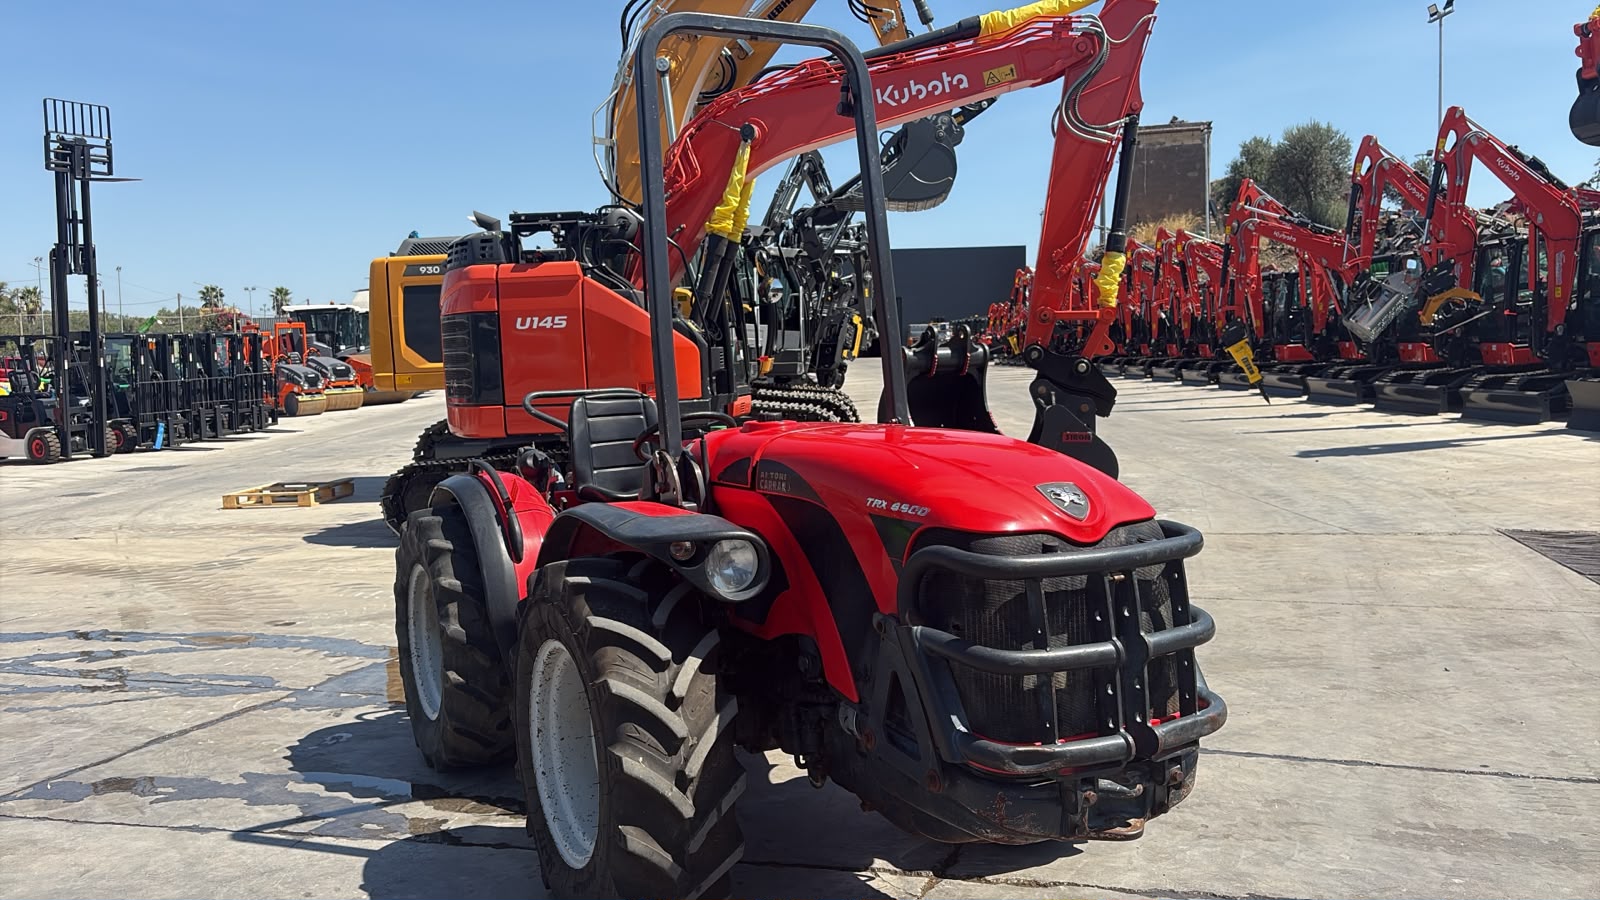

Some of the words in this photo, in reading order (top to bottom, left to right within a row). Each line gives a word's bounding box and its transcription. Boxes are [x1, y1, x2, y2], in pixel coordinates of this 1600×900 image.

[876, 71, 969, 107] Kubota
[1496, 157, 1521, 181] Kubota
[1405, 180, 1425, 202] Kubota
[419, 265, 440, 274] 930
[515, 315, 568, 330] U145
[865, 497, 888, 510] TRX
